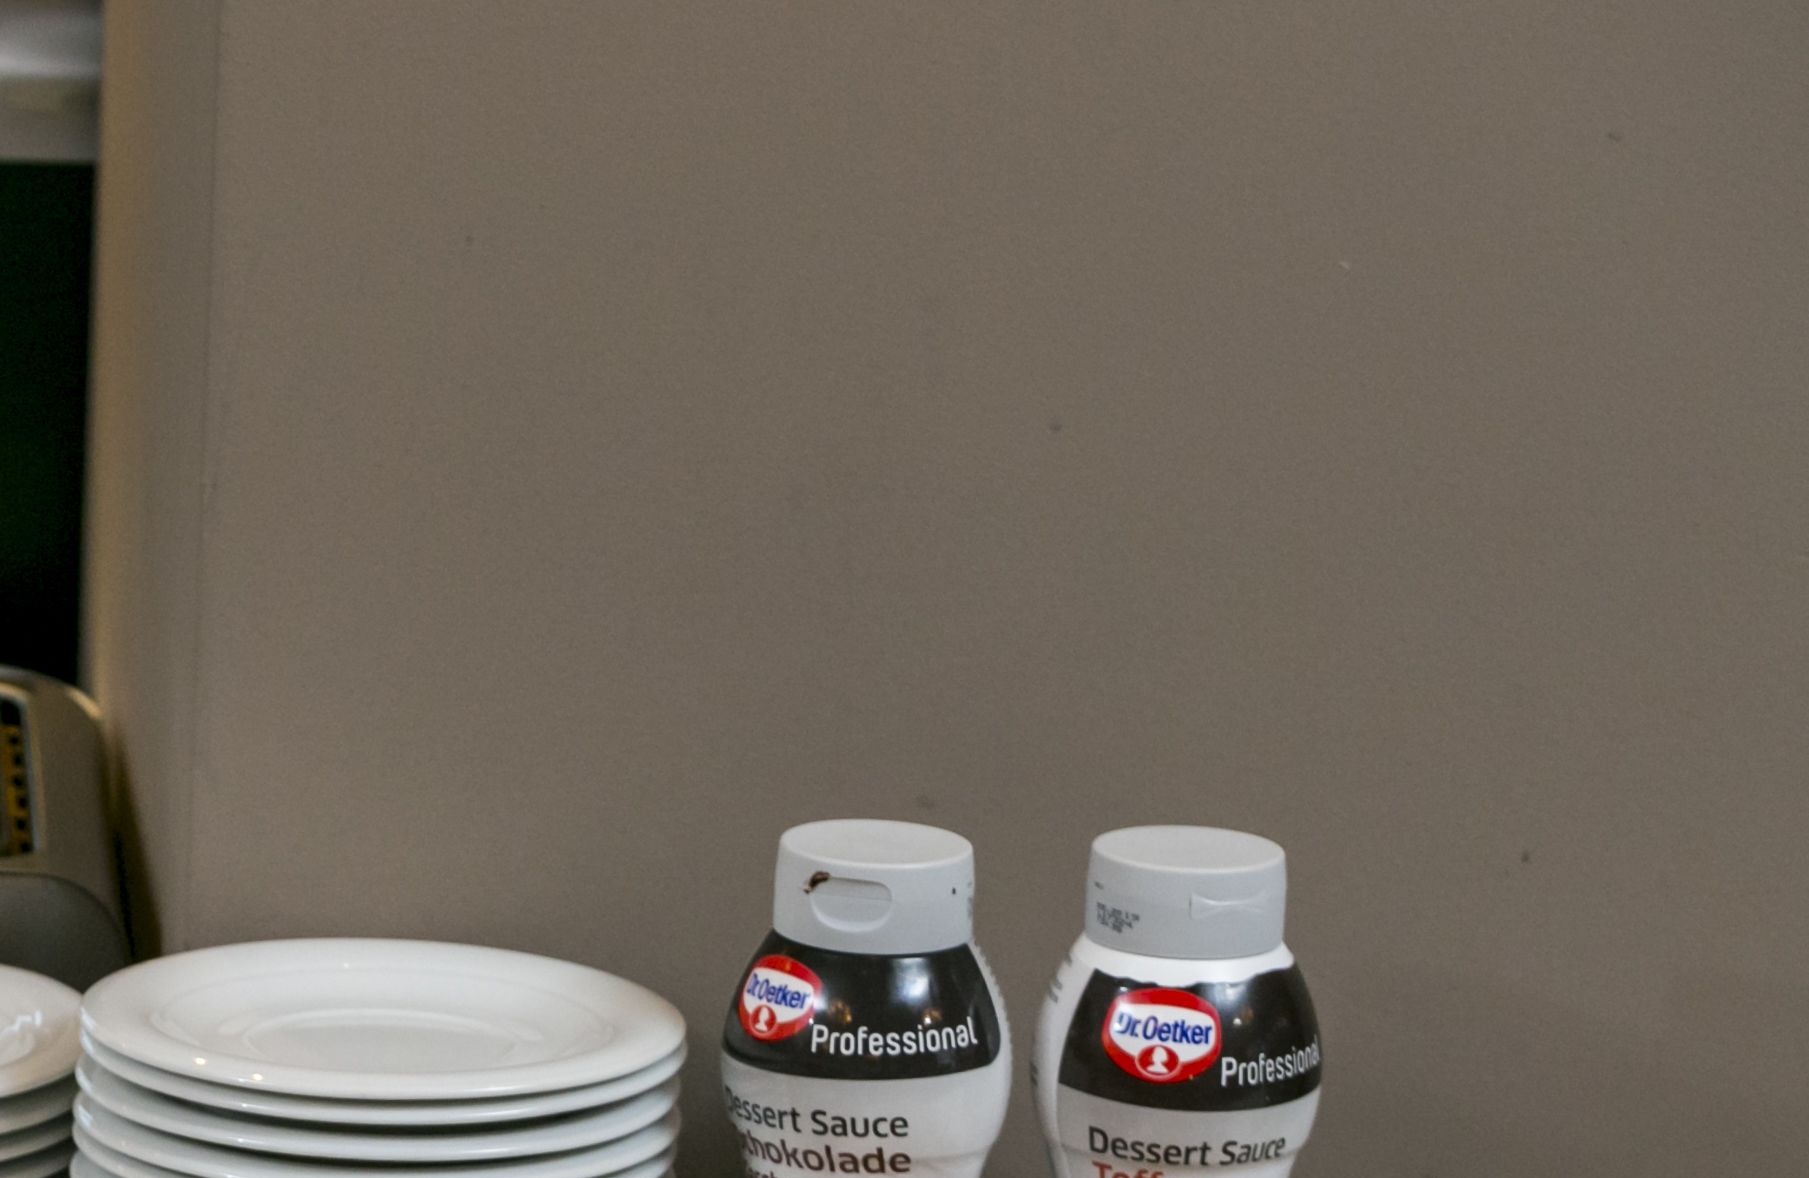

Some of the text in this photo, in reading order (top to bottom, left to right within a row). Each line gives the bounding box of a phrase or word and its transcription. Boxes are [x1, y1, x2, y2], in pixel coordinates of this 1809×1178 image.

[811, 1016, 978, 1056] Professional
[1220, 1034, 1320, 1087] Professional
[811, 1109, 909, 1138] Sauce
[1088, 1125, 1286, 1166] Dessert Sauce
